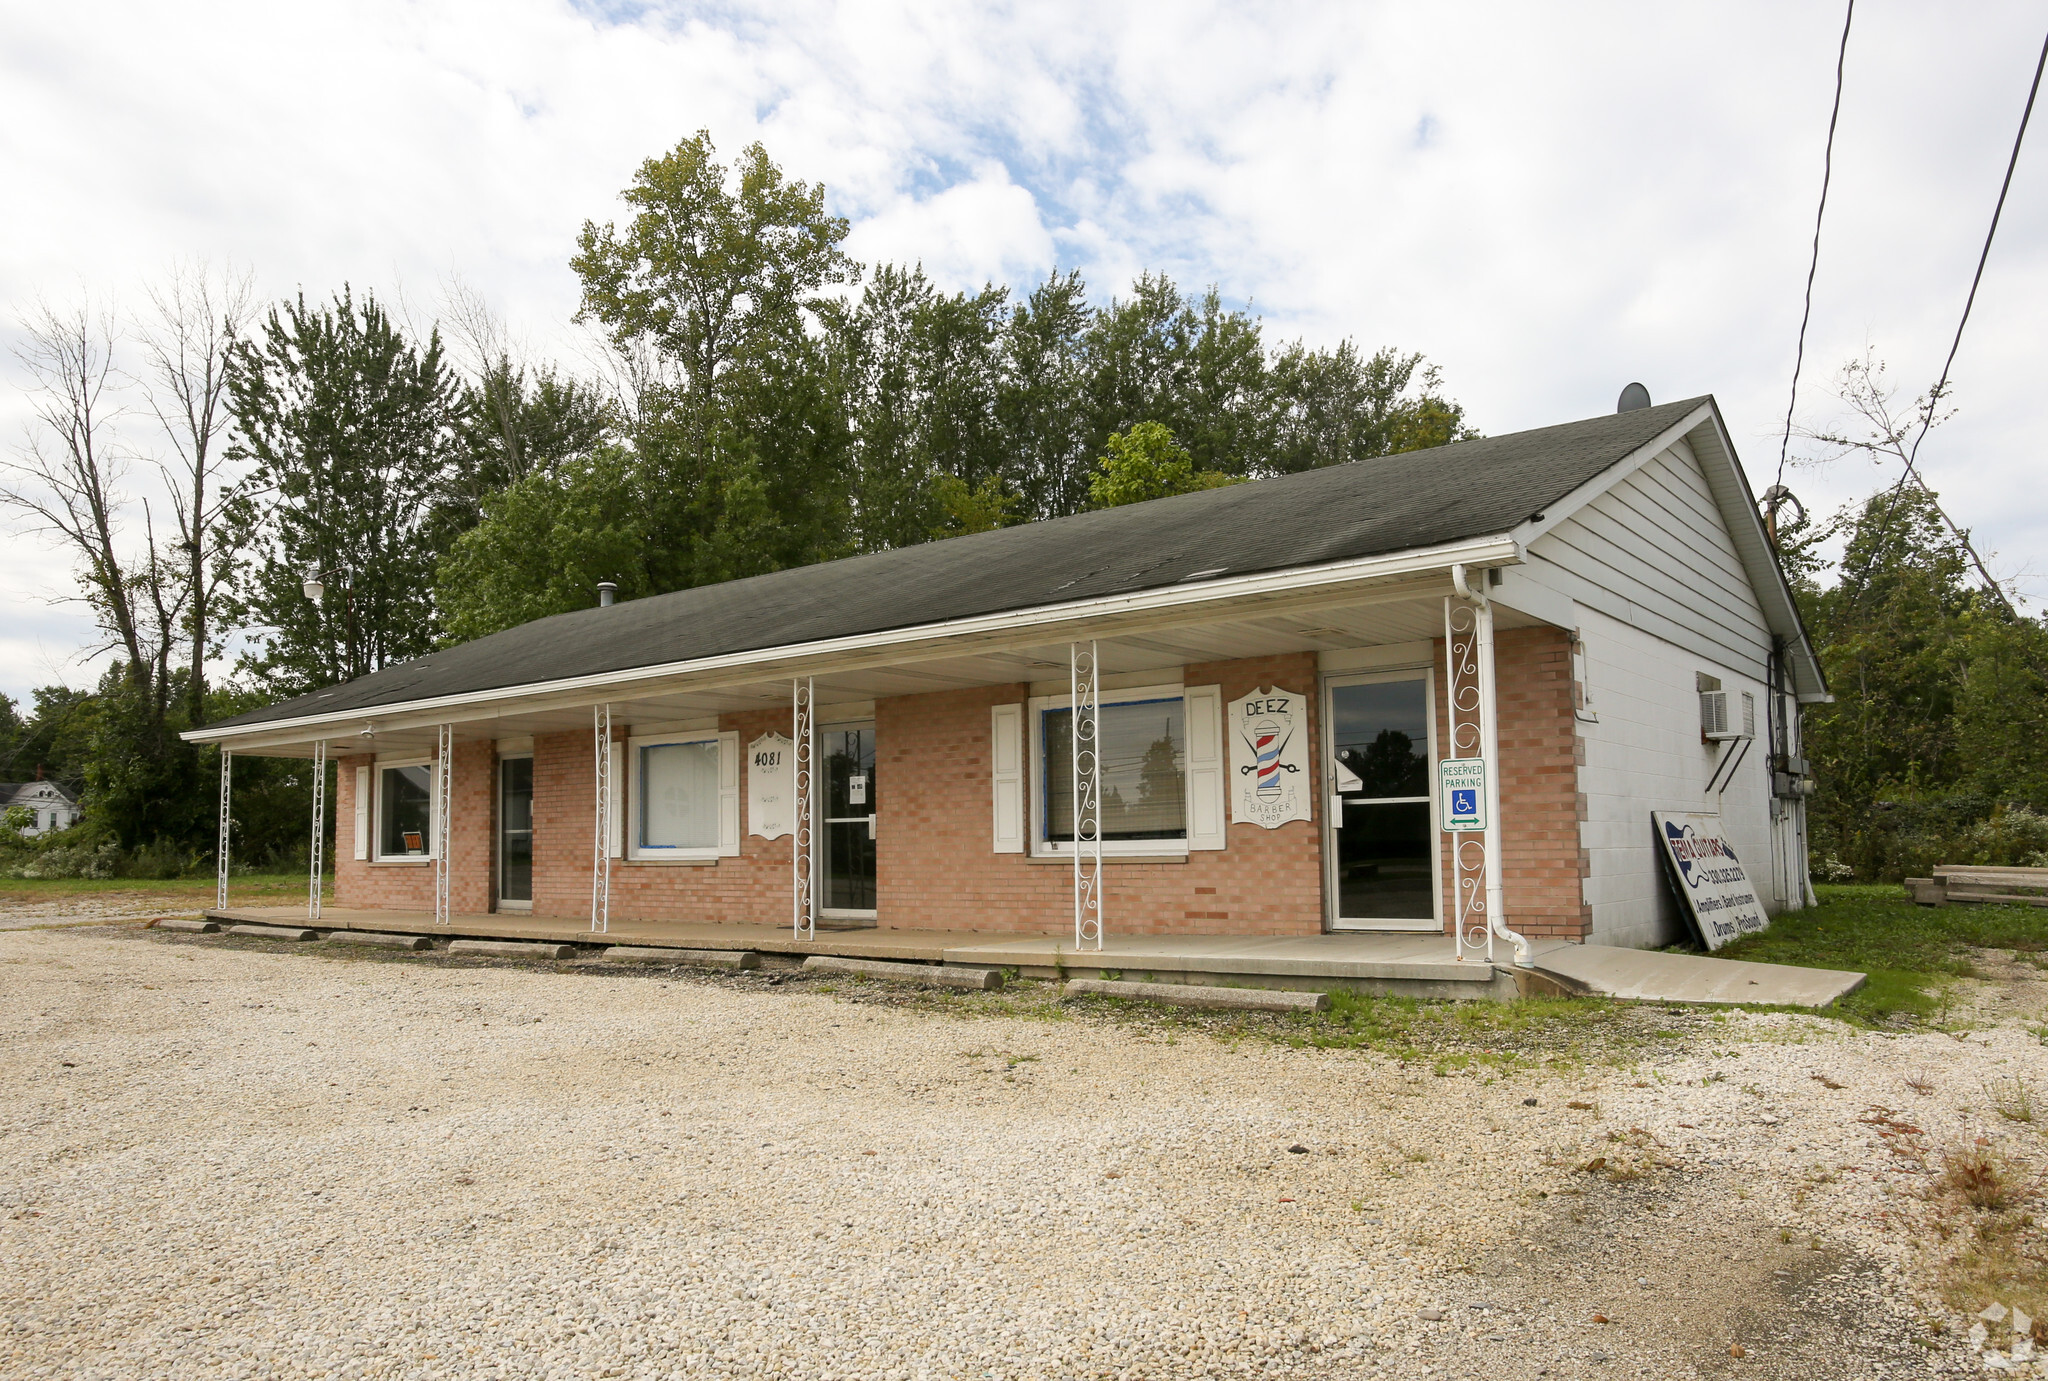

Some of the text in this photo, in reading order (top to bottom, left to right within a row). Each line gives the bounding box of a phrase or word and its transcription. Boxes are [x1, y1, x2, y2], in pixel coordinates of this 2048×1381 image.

[1246, 698, 1290, 716] DEEZ
[754, 751, 781, 766] 4081
[1443, 766, 1482, 776] RESERVED
[1445, 778, 1482, 788] PARKING
[1250, 803, 1292, 814] BARBER
[1260, 814, 1281, 822] SHOP
[1693, 838, 1724, 858] GUITARS
[1697, 897, 1723, 915] Amplifiers
[1722, 894, 1736, 908] Band
[1713, 913, 1762, 937] Drums ProSound
